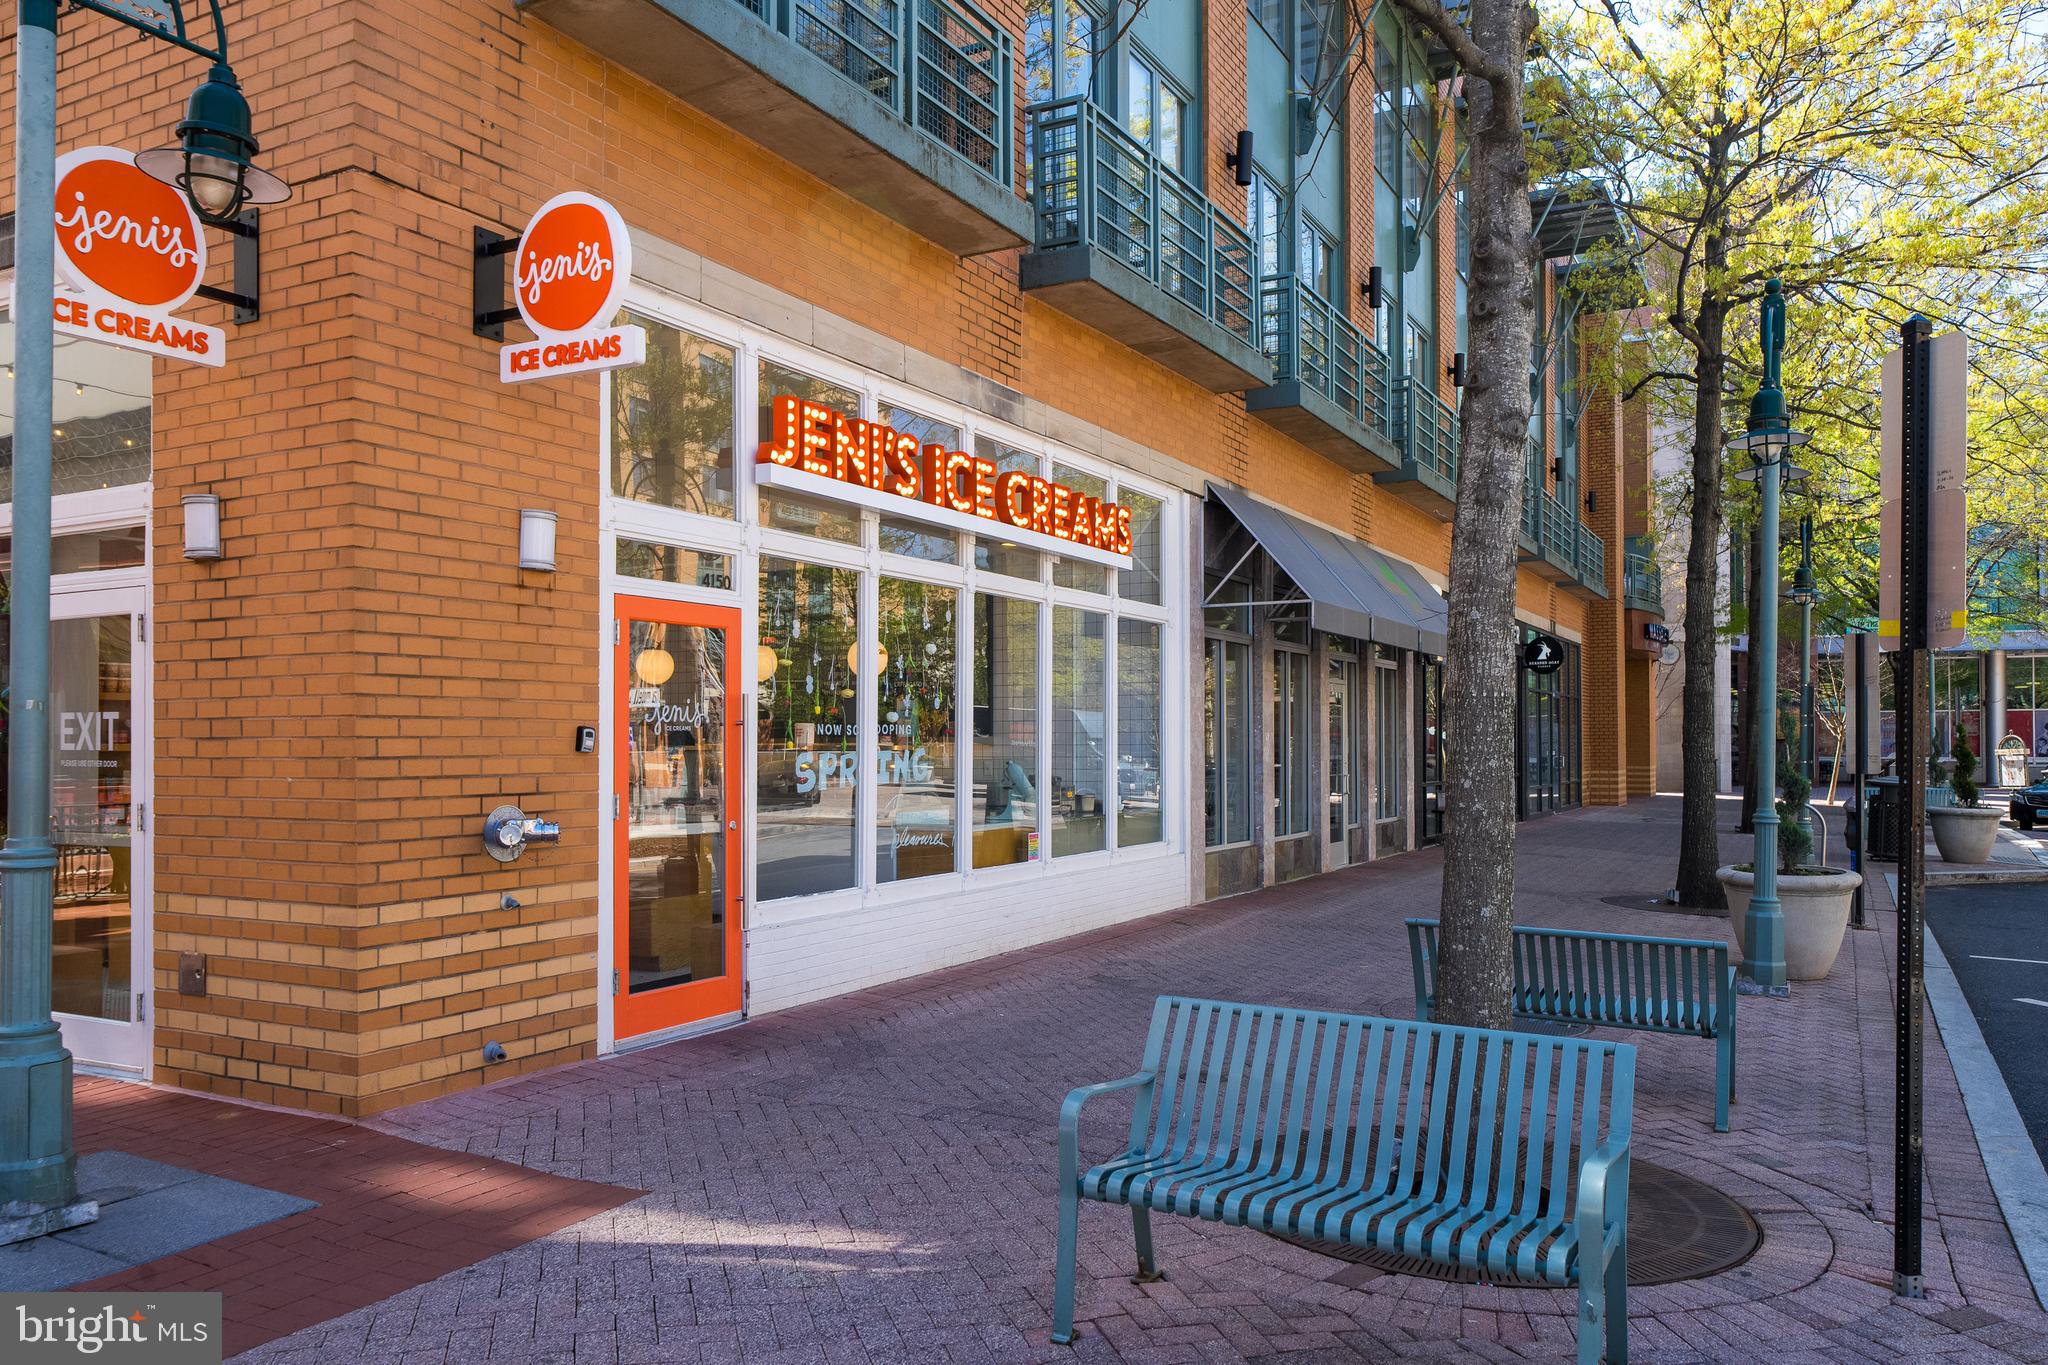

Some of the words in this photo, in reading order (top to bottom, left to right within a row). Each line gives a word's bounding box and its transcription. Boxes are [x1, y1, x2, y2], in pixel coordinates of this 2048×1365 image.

[55, 191, 199, 268] jeni's
[519, 241, 612, 304] jeni's
[53, 298, 88, 327] CE
[94, 308, 209, 354] CREAMS
[510, 348, 539, 373] ICE
[542, 335, 621, 368] CREAMS
[757, 395, 919, 499] JENI'S
[922, 444, 999, 518] ICE
[996, 470, 1132, 556] CREAMS
[702, 573, 732, 590] 4150
[60, 711, 119, 751] EXIT
[817, 723, 842, 735] NOW
[103, 760, 118, 768] DOOR
[795, 748, 929, 793] SPRING
